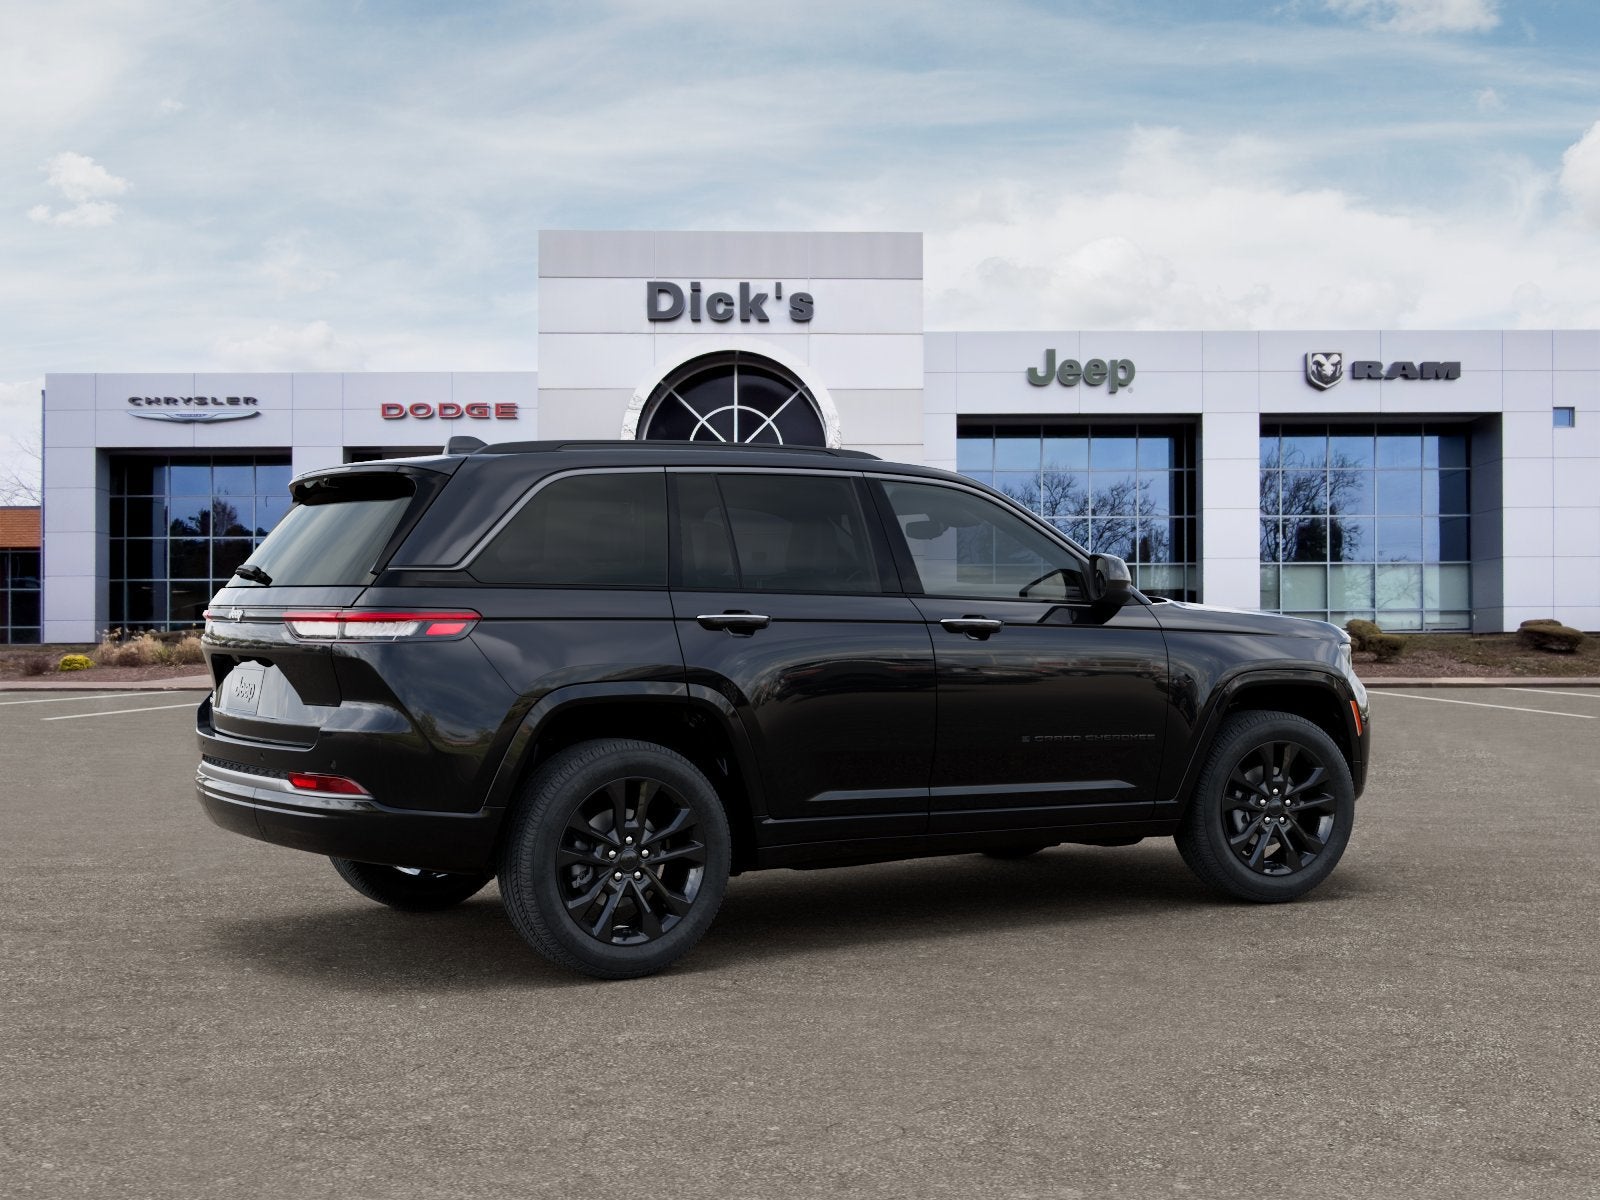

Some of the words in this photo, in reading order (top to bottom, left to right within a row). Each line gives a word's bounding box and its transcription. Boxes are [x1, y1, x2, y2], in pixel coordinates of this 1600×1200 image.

[647, 281, 814, 322] Dick's
[1027, 348, 1136, 394] Jeep
[1351, 360, 1461, 380] RAM
[127, 396, 258, 406] CHRYSLER
[381, 402, 518, 420] DODGE
[235, 676, 256, 703] Jeep
